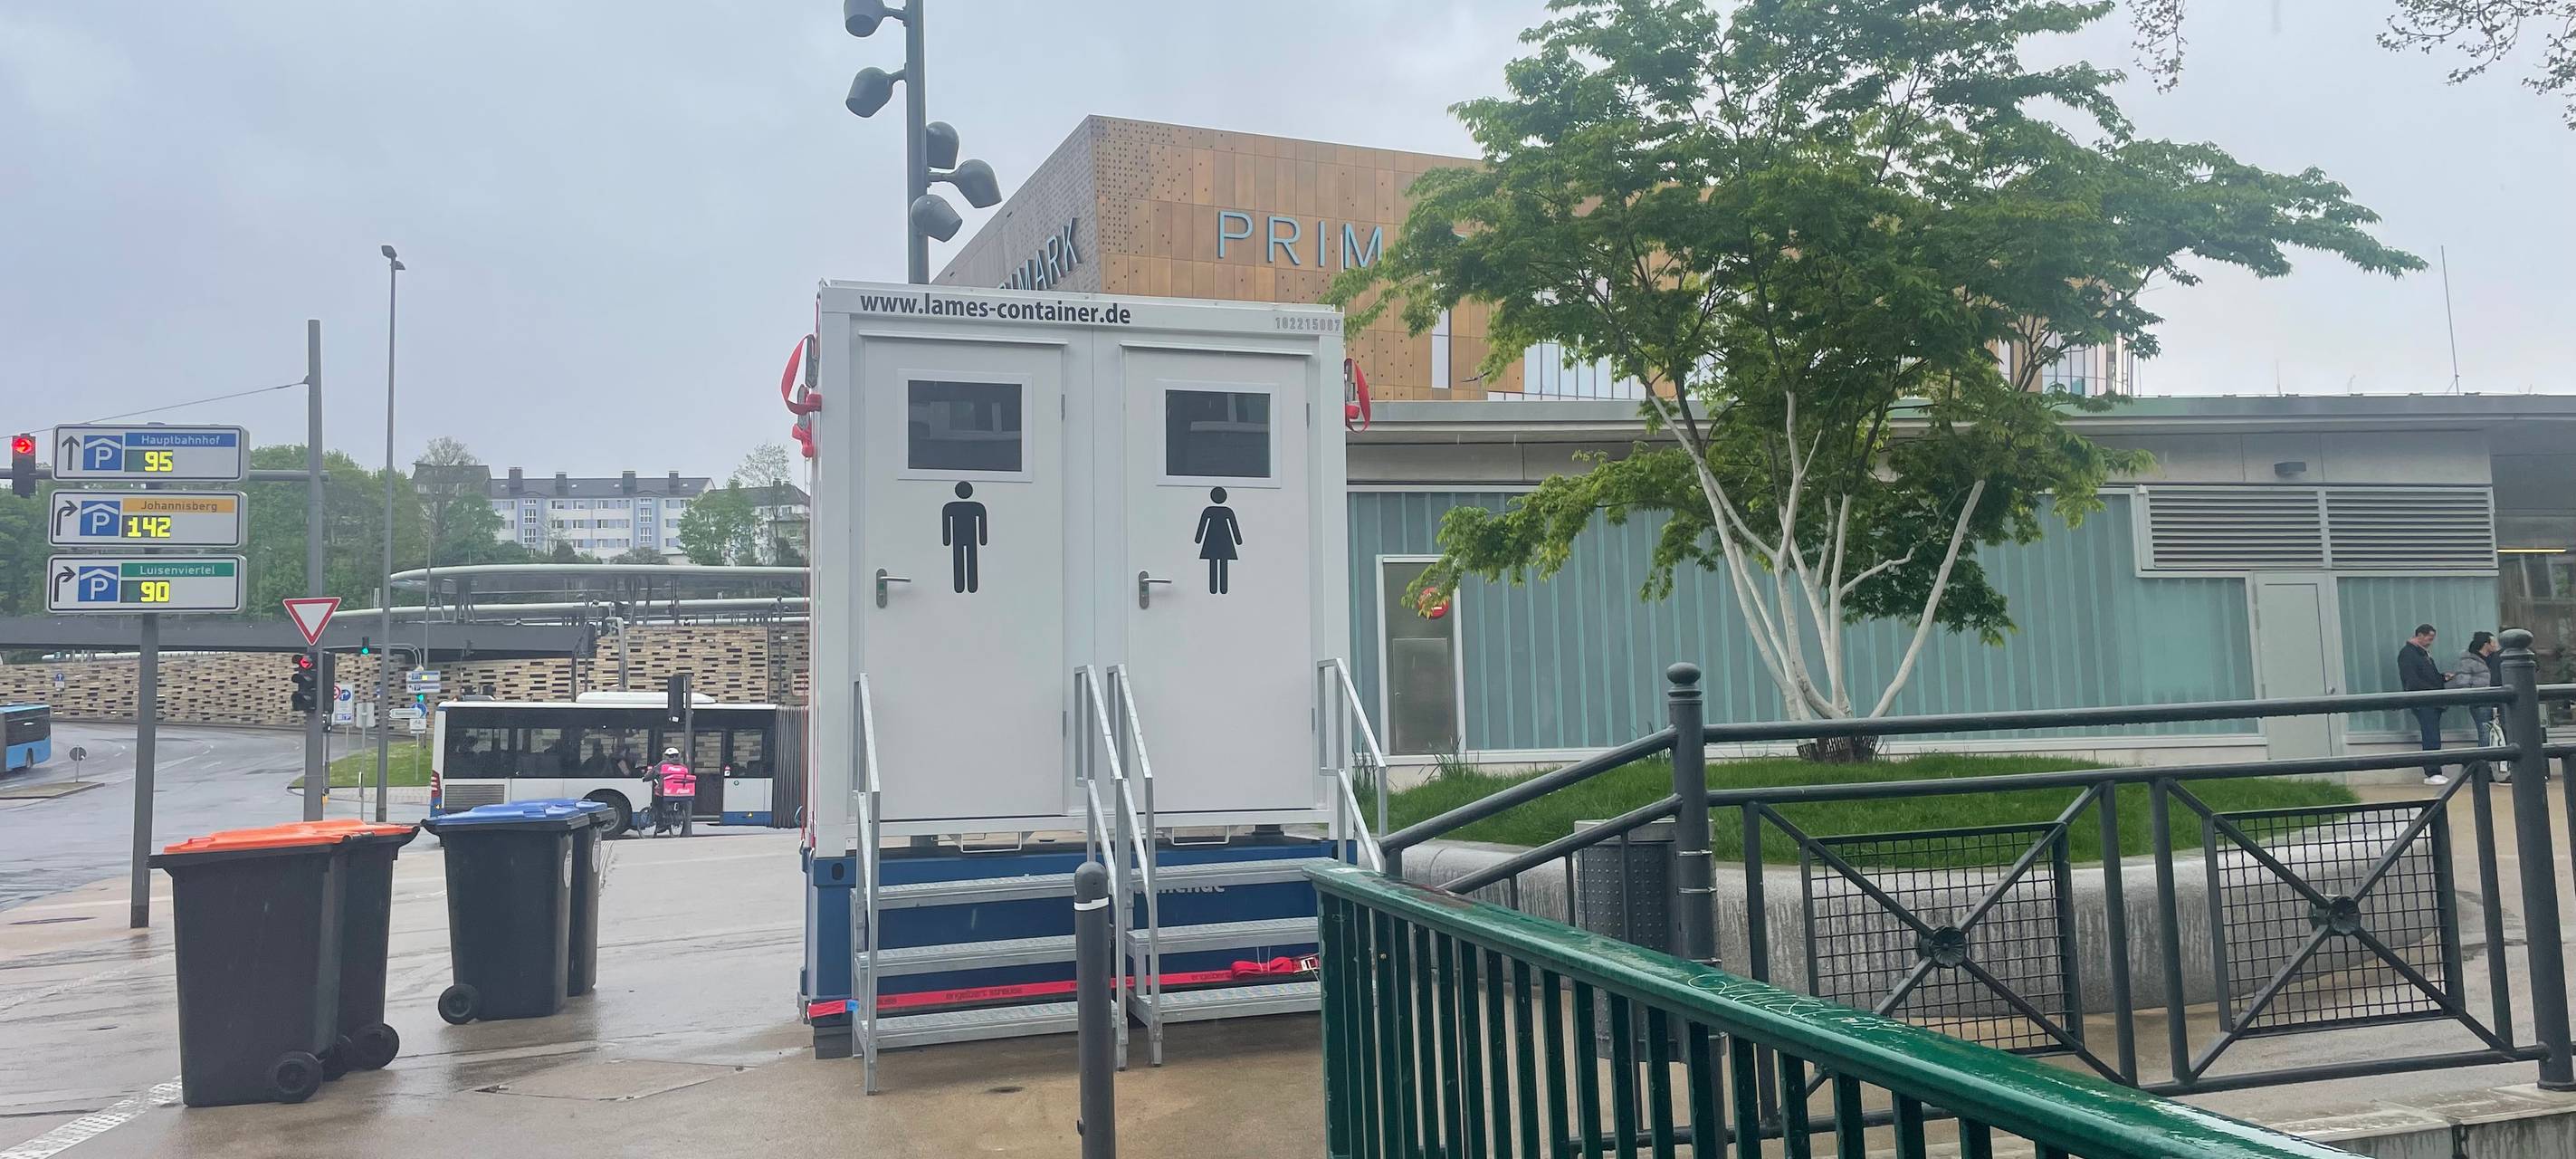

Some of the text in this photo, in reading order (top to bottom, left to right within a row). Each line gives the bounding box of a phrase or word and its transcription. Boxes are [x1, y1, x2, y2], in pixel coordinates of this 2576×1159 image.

[1217, 210, 1383, 269] PRIM
[860, 292, 1131, 325] www.lames-container.de
[141, 435, 221, 446] Hauptbahnhof
[144, 451, 174, 472] 95
[141, 500, 218, 512] Johannisberg
[127, 517, 171, 538] 142
[139, 565, 215, 576] Luisenviertel
[140, 581, 170, 602] 90
